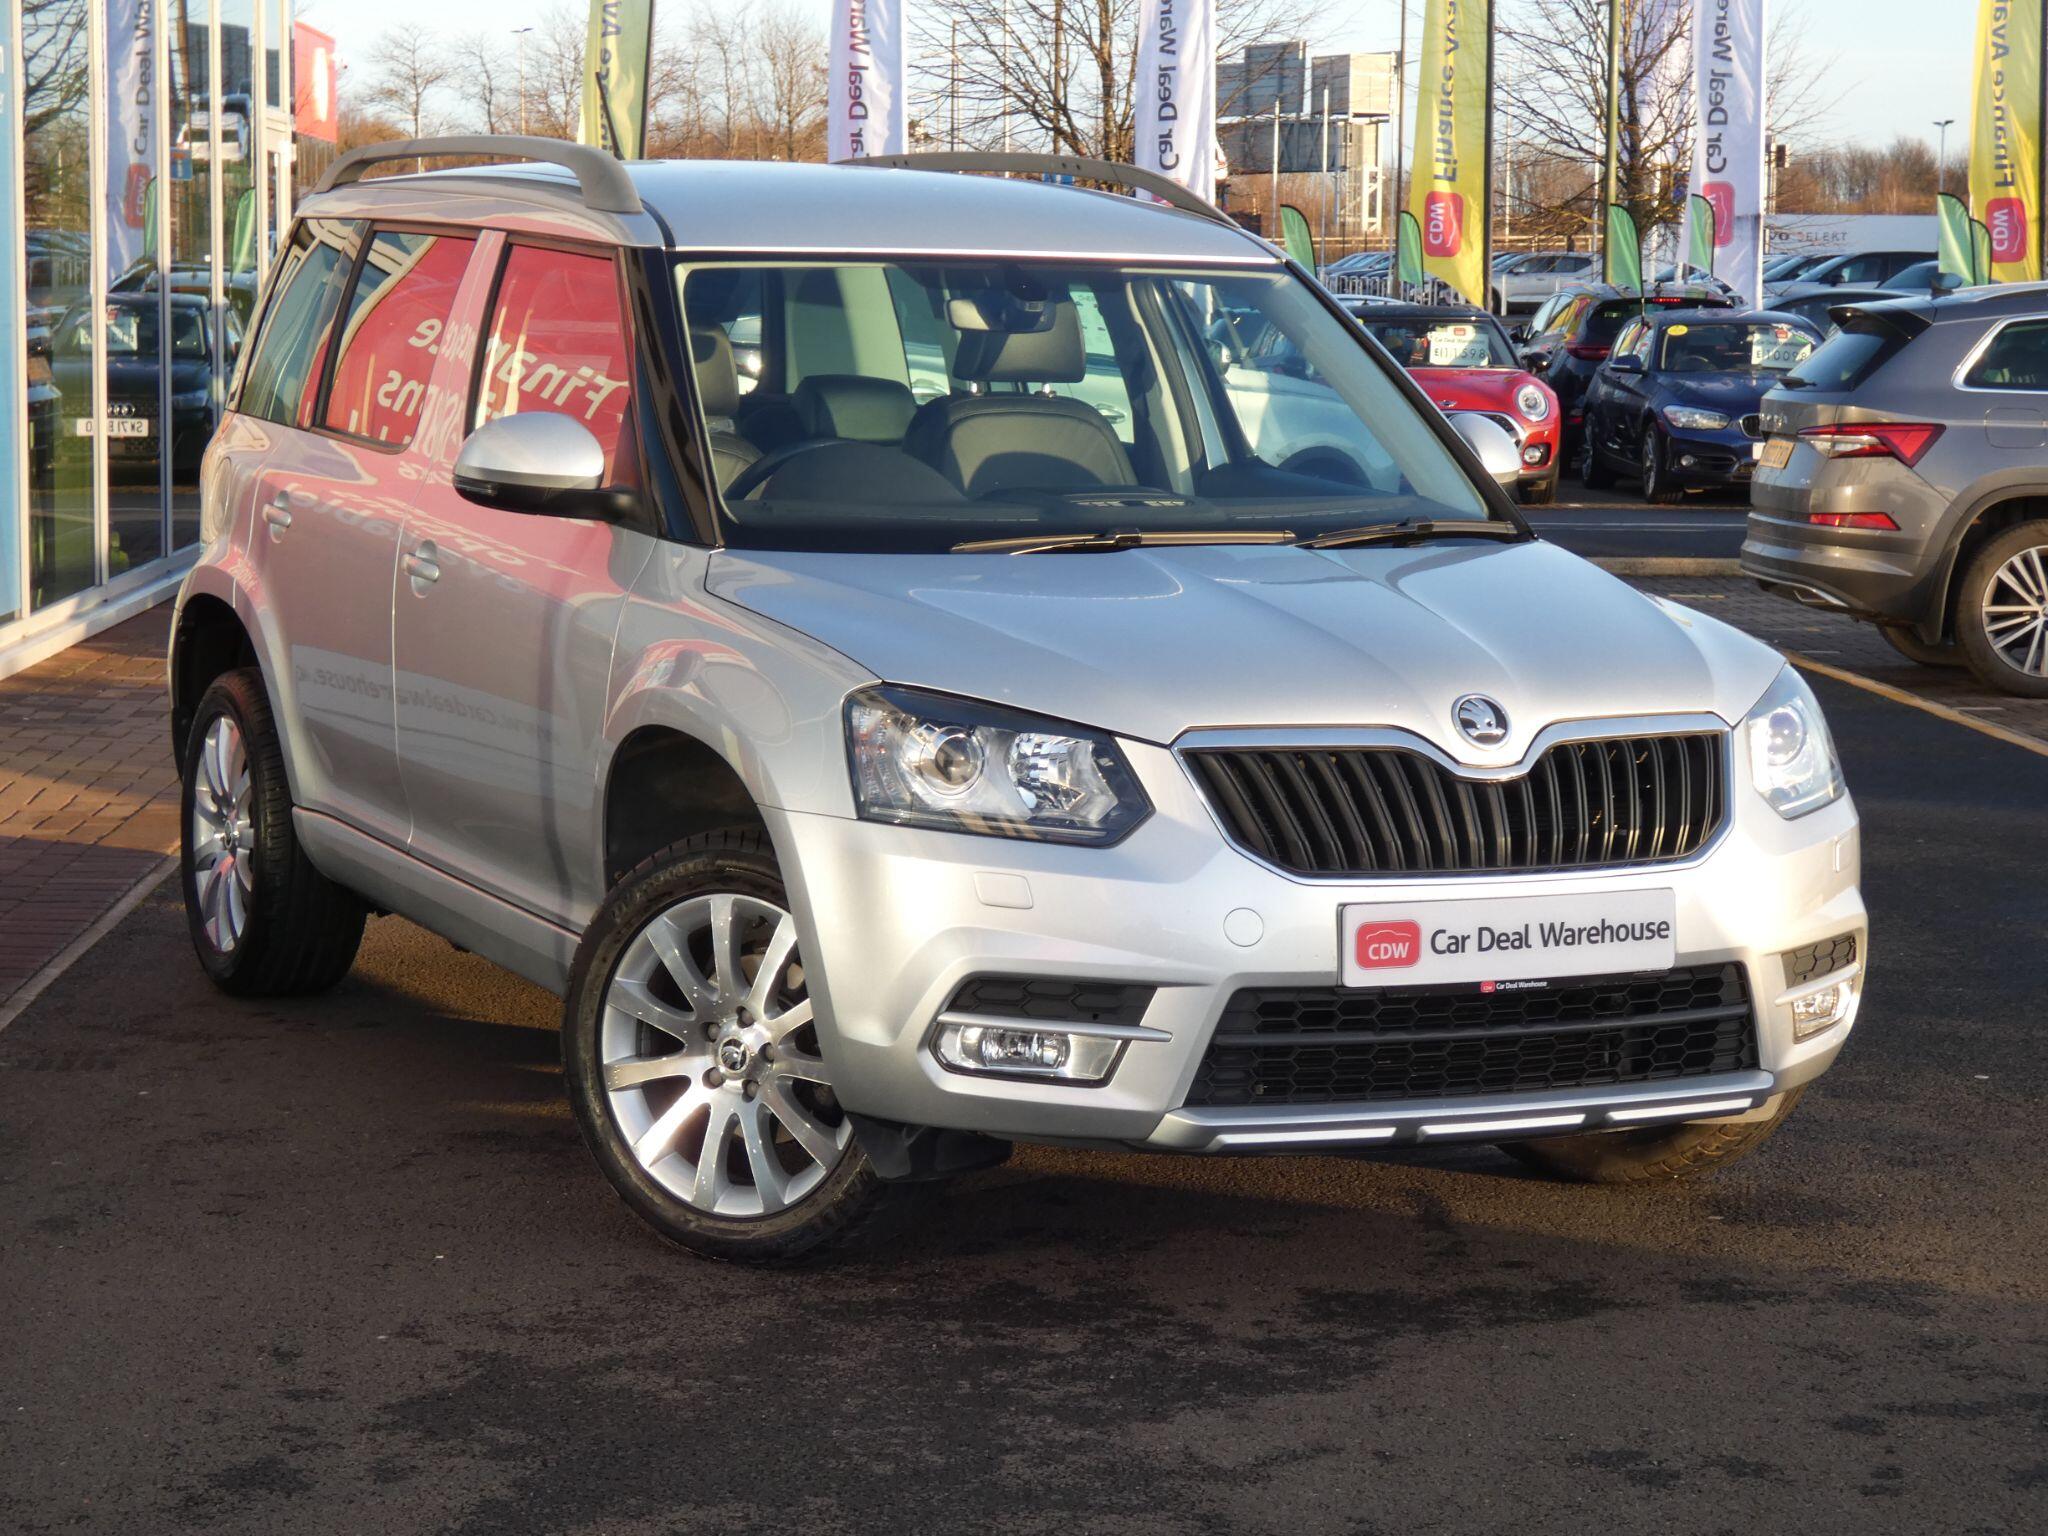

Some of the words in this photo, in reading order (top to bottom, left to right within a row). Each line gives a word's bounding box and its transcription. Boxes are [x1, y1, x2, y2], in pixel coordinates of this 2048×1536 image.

[135, 48, 151, 106] Deal
[134, 114, 149, 156] Car
[1368, 942, 1410, 960] CDW
[1430, 929, 1471, 955] Car
[1477, 923, 1532, 953] Deal
[1538, 918, 1670, 948] Warehouse
[1496, 982, 1505, 990] Car
[1505, 981, 1518, 989] Deal
